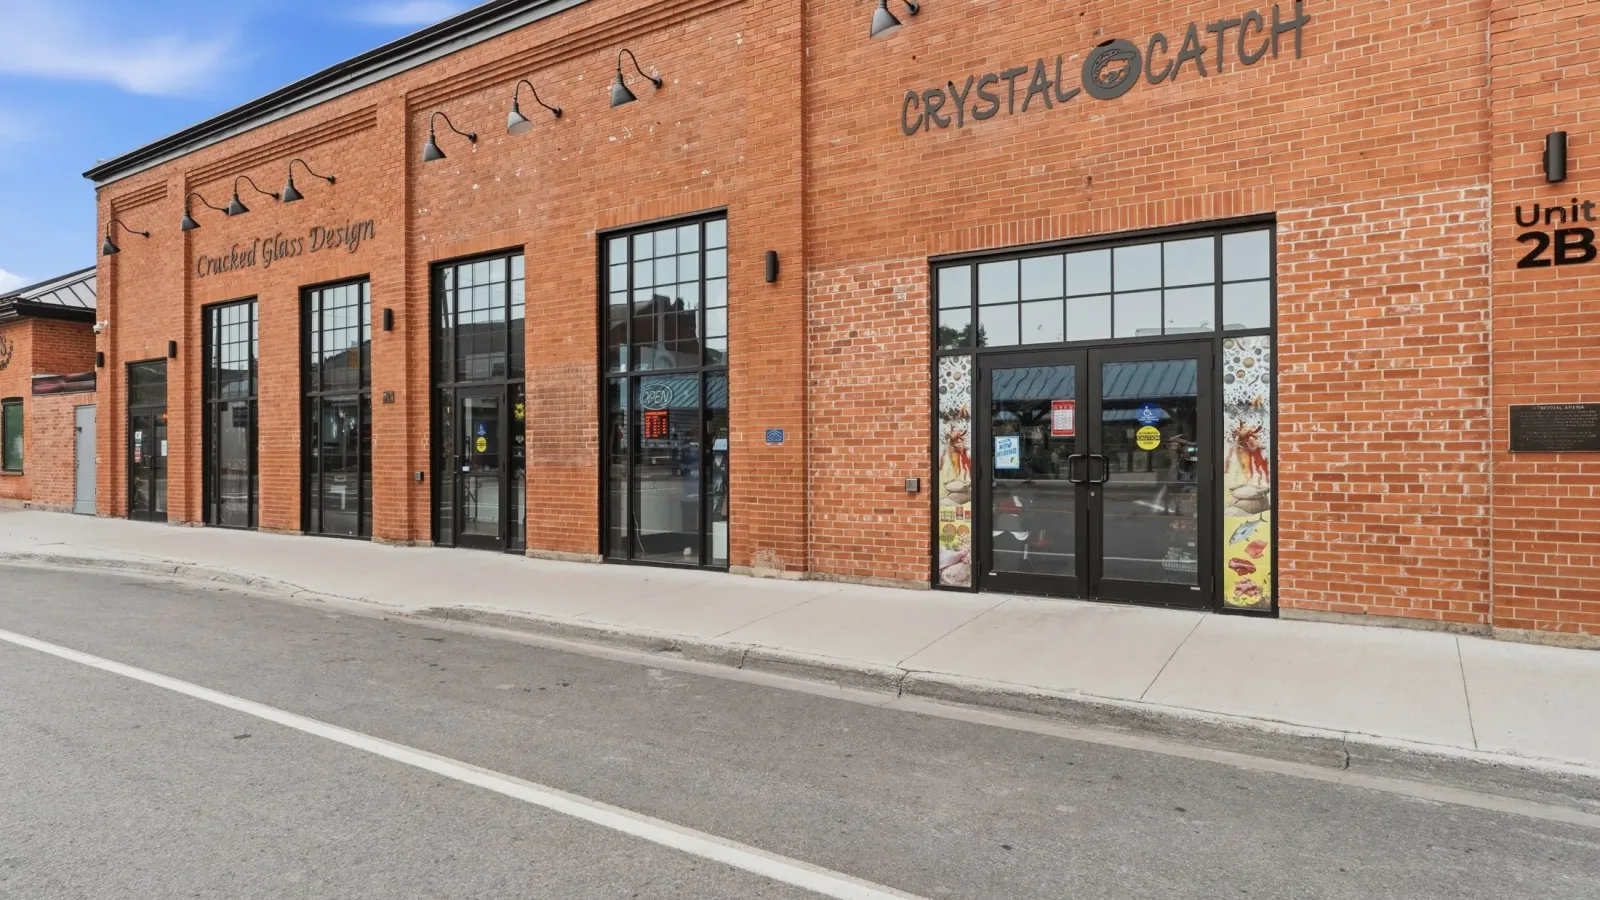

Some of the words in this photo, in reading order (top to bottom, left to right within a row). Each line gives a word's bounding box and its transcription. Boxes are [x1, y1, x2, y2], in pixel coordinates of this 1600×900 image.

[901, 54, 1081, 136] CRYSTAL
[1144, 0, 1312, 86] CATCH
[1515, 197, 1597, 228] Unit
[197, 237, 260, 277] Cracked
[262, 232, 304, 269] Glass
[309, 218, 376, 253] Design
[1516, 227, 1598, 269] 2B
[641, 390, 669, 404] OPEN
